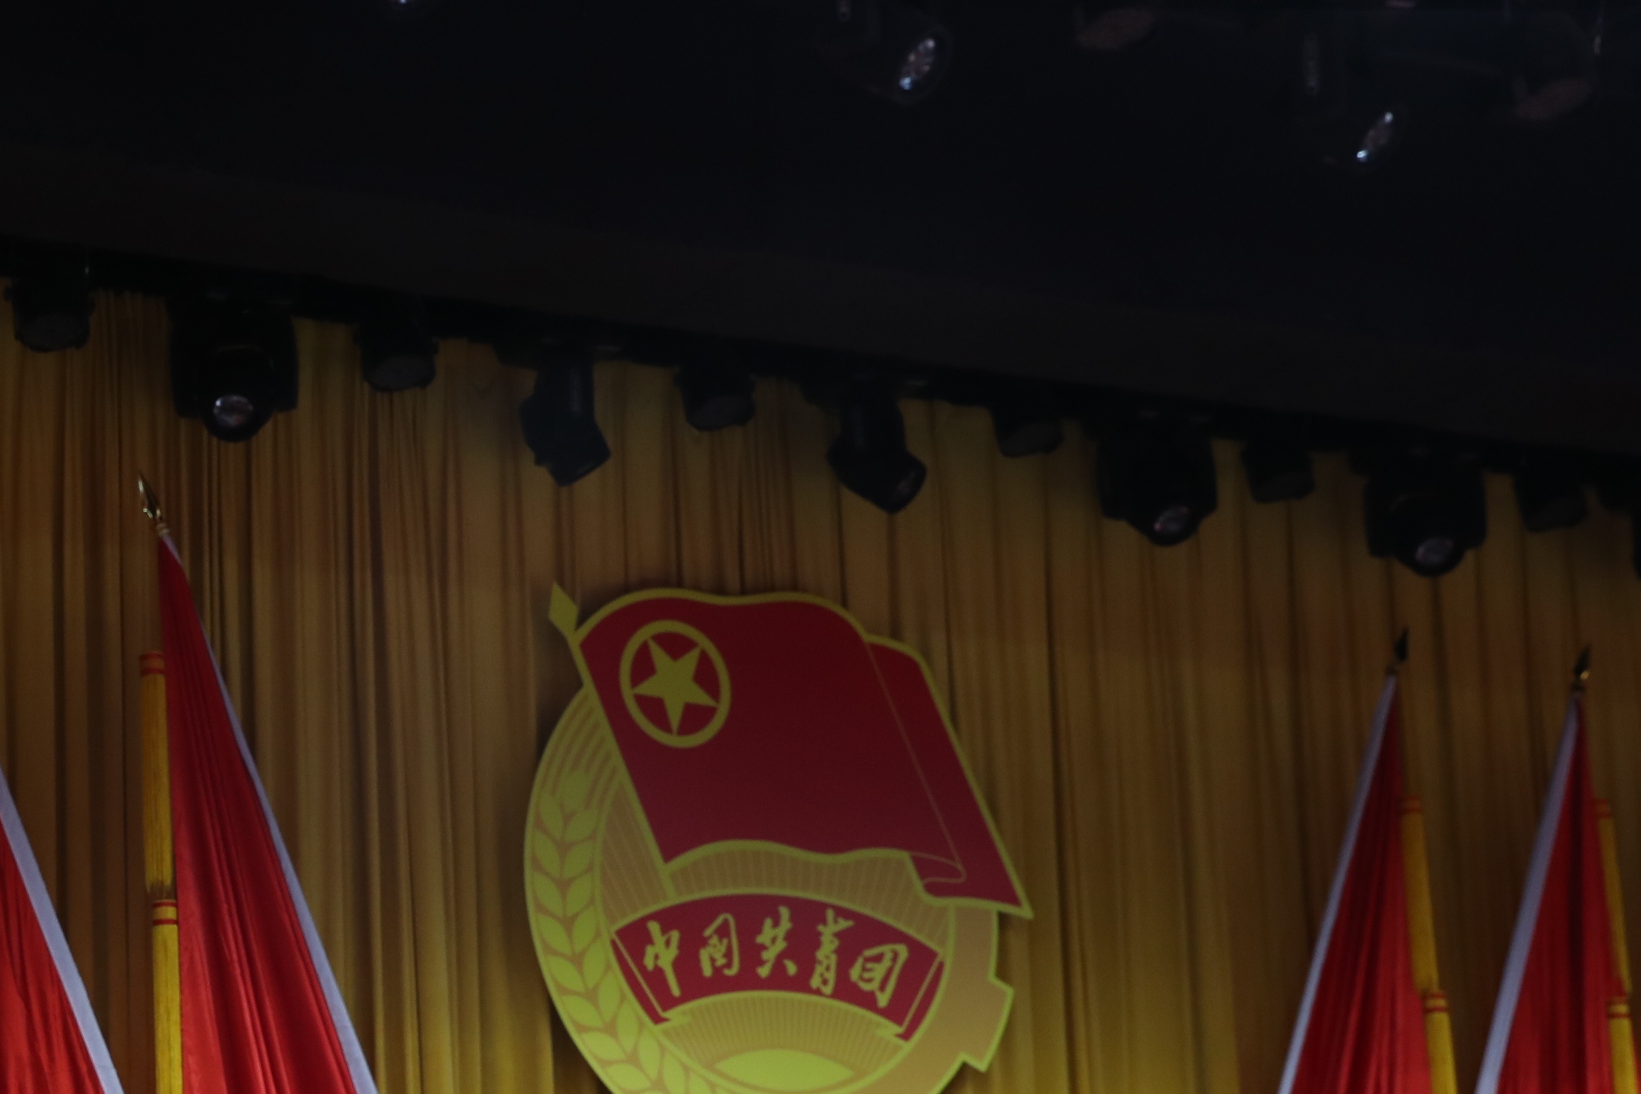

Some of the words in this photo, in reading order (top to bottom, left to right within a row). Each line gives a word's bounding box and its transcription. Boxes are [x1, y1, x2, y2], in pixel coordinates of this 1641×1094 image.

[643, 906, 909, 1008] 中国共青团
